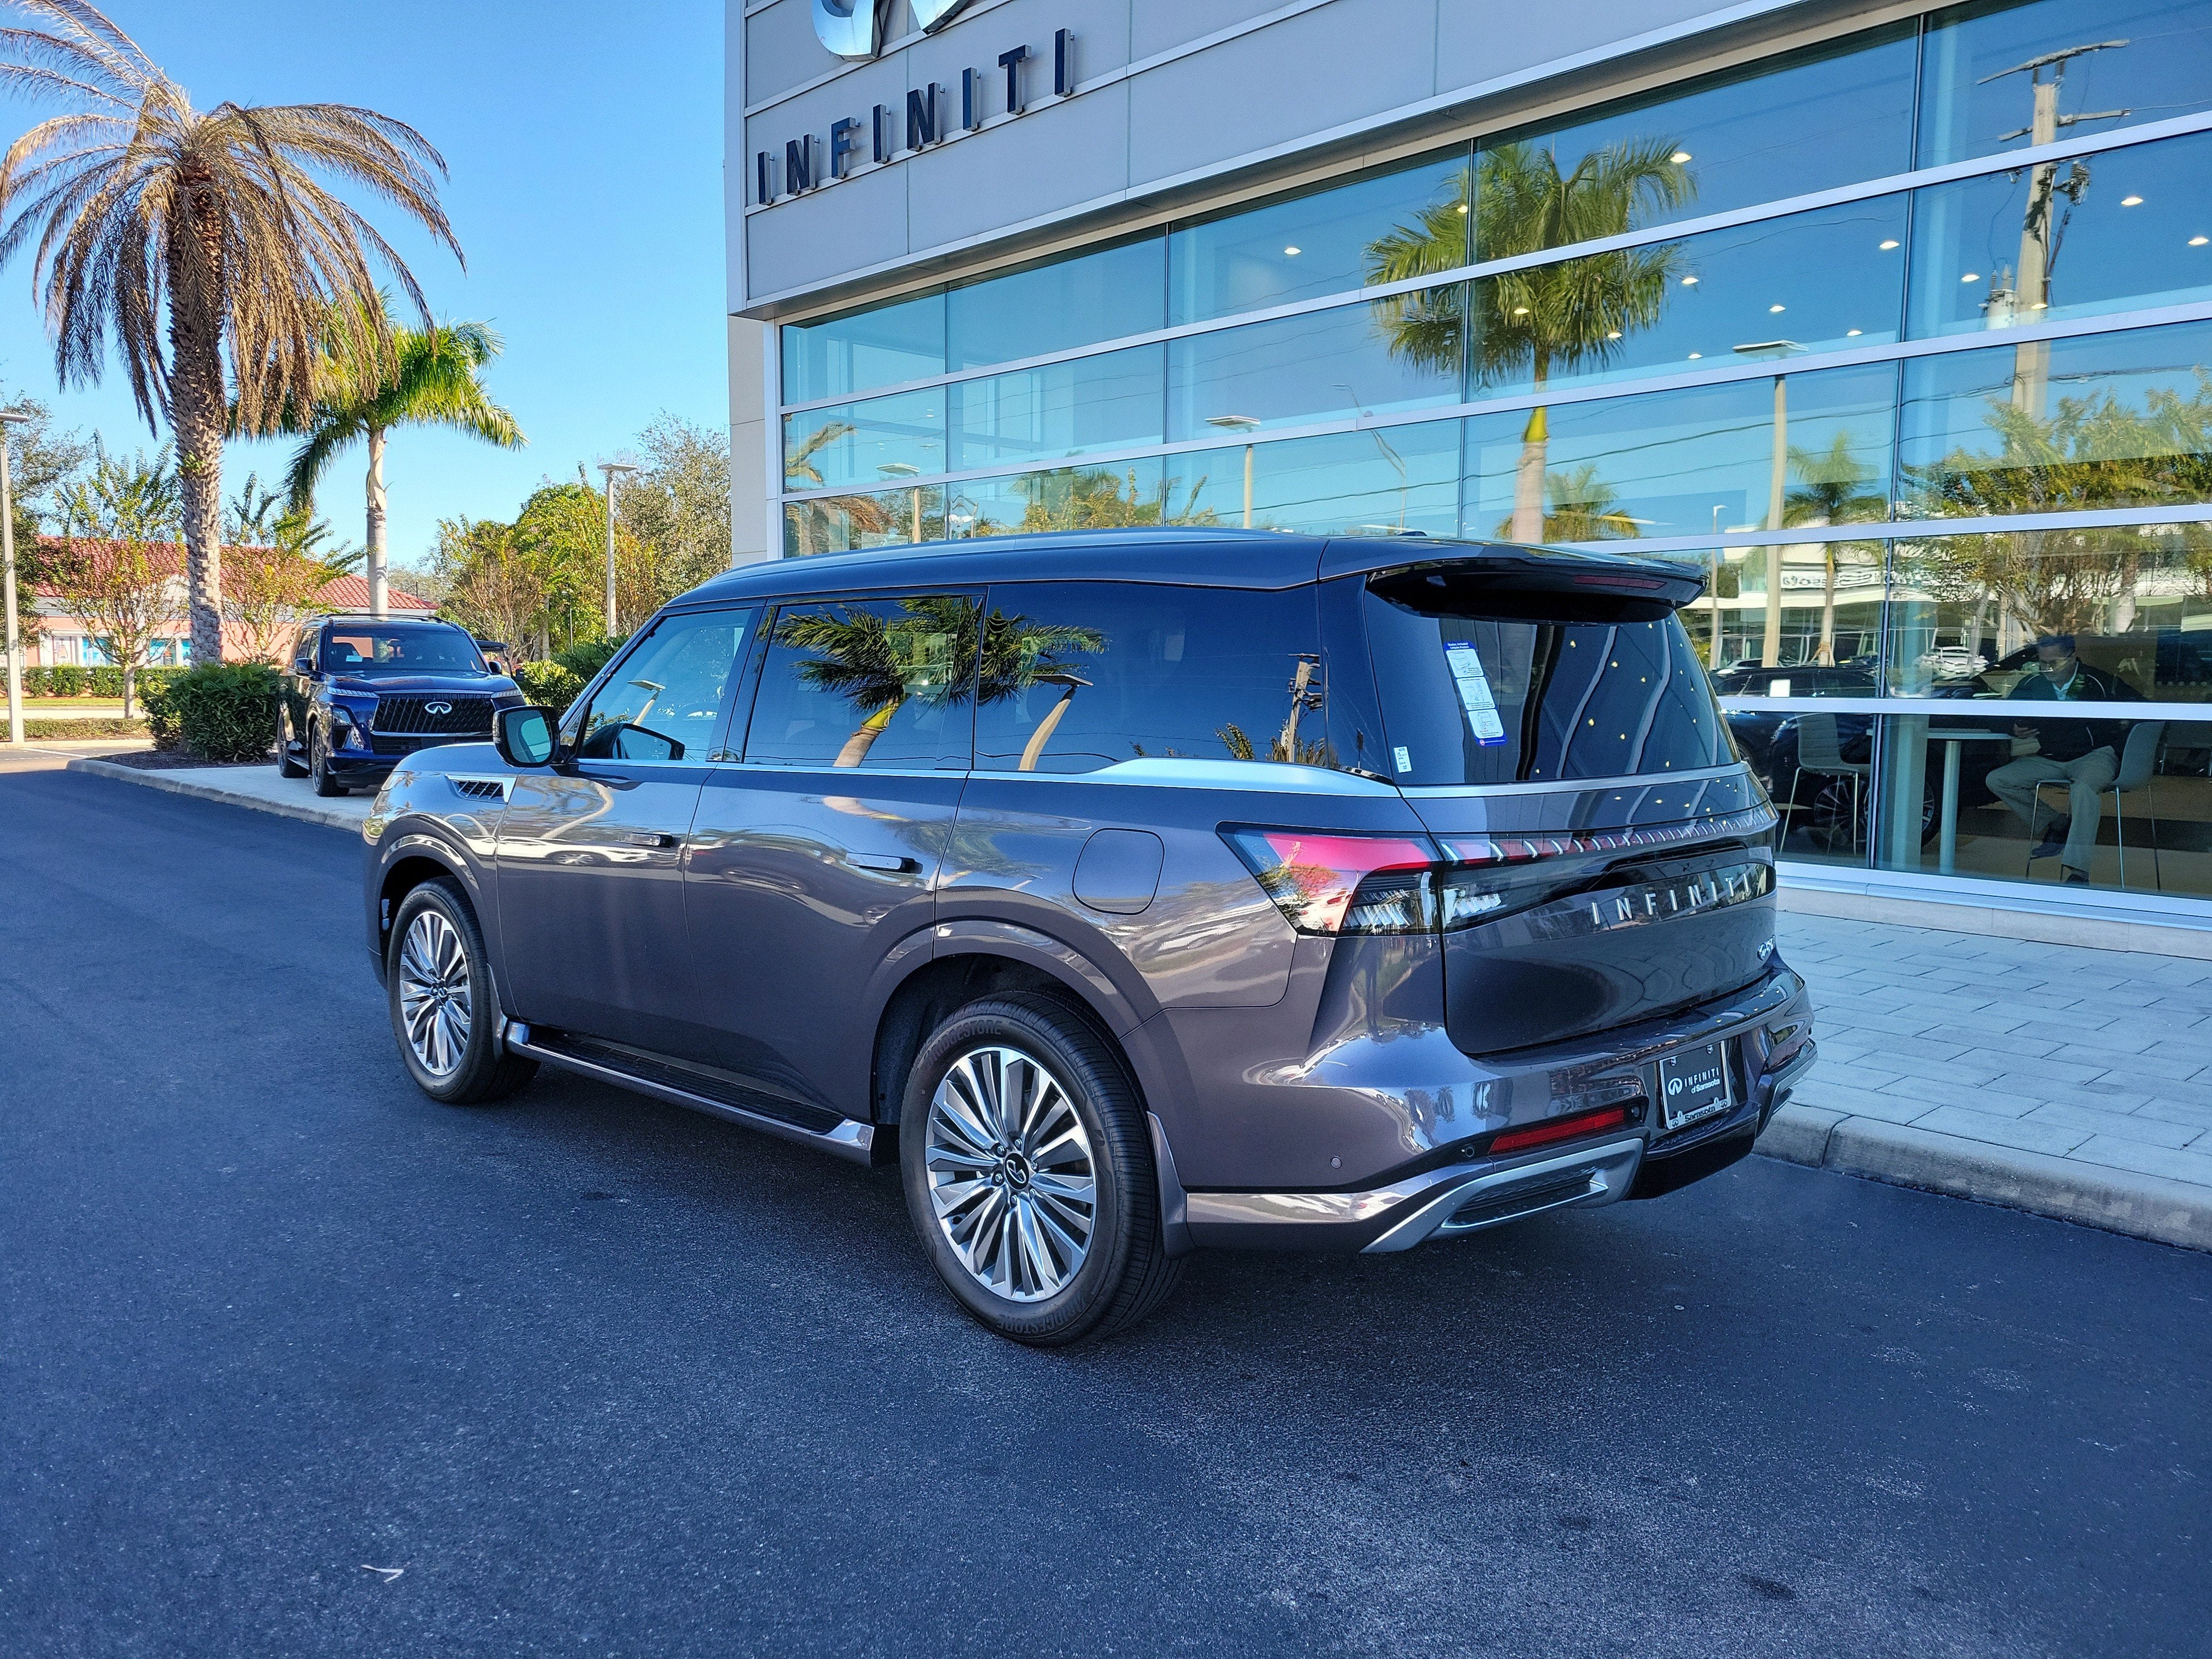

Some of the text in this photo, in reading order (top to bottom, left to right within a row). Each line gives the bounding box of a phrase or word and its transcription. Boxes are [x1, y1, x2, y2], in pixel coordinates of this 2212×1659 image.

[757, 28, 1073, 206] INFINITI
[1592, 873, 1751, 924] INFINITI
[1684, 1067, 1719, 1088] INFINITI
[1691, 1078, 1720, 1094] of Sarasota
[1684, 1105, 1716, 1122] Sarasota
